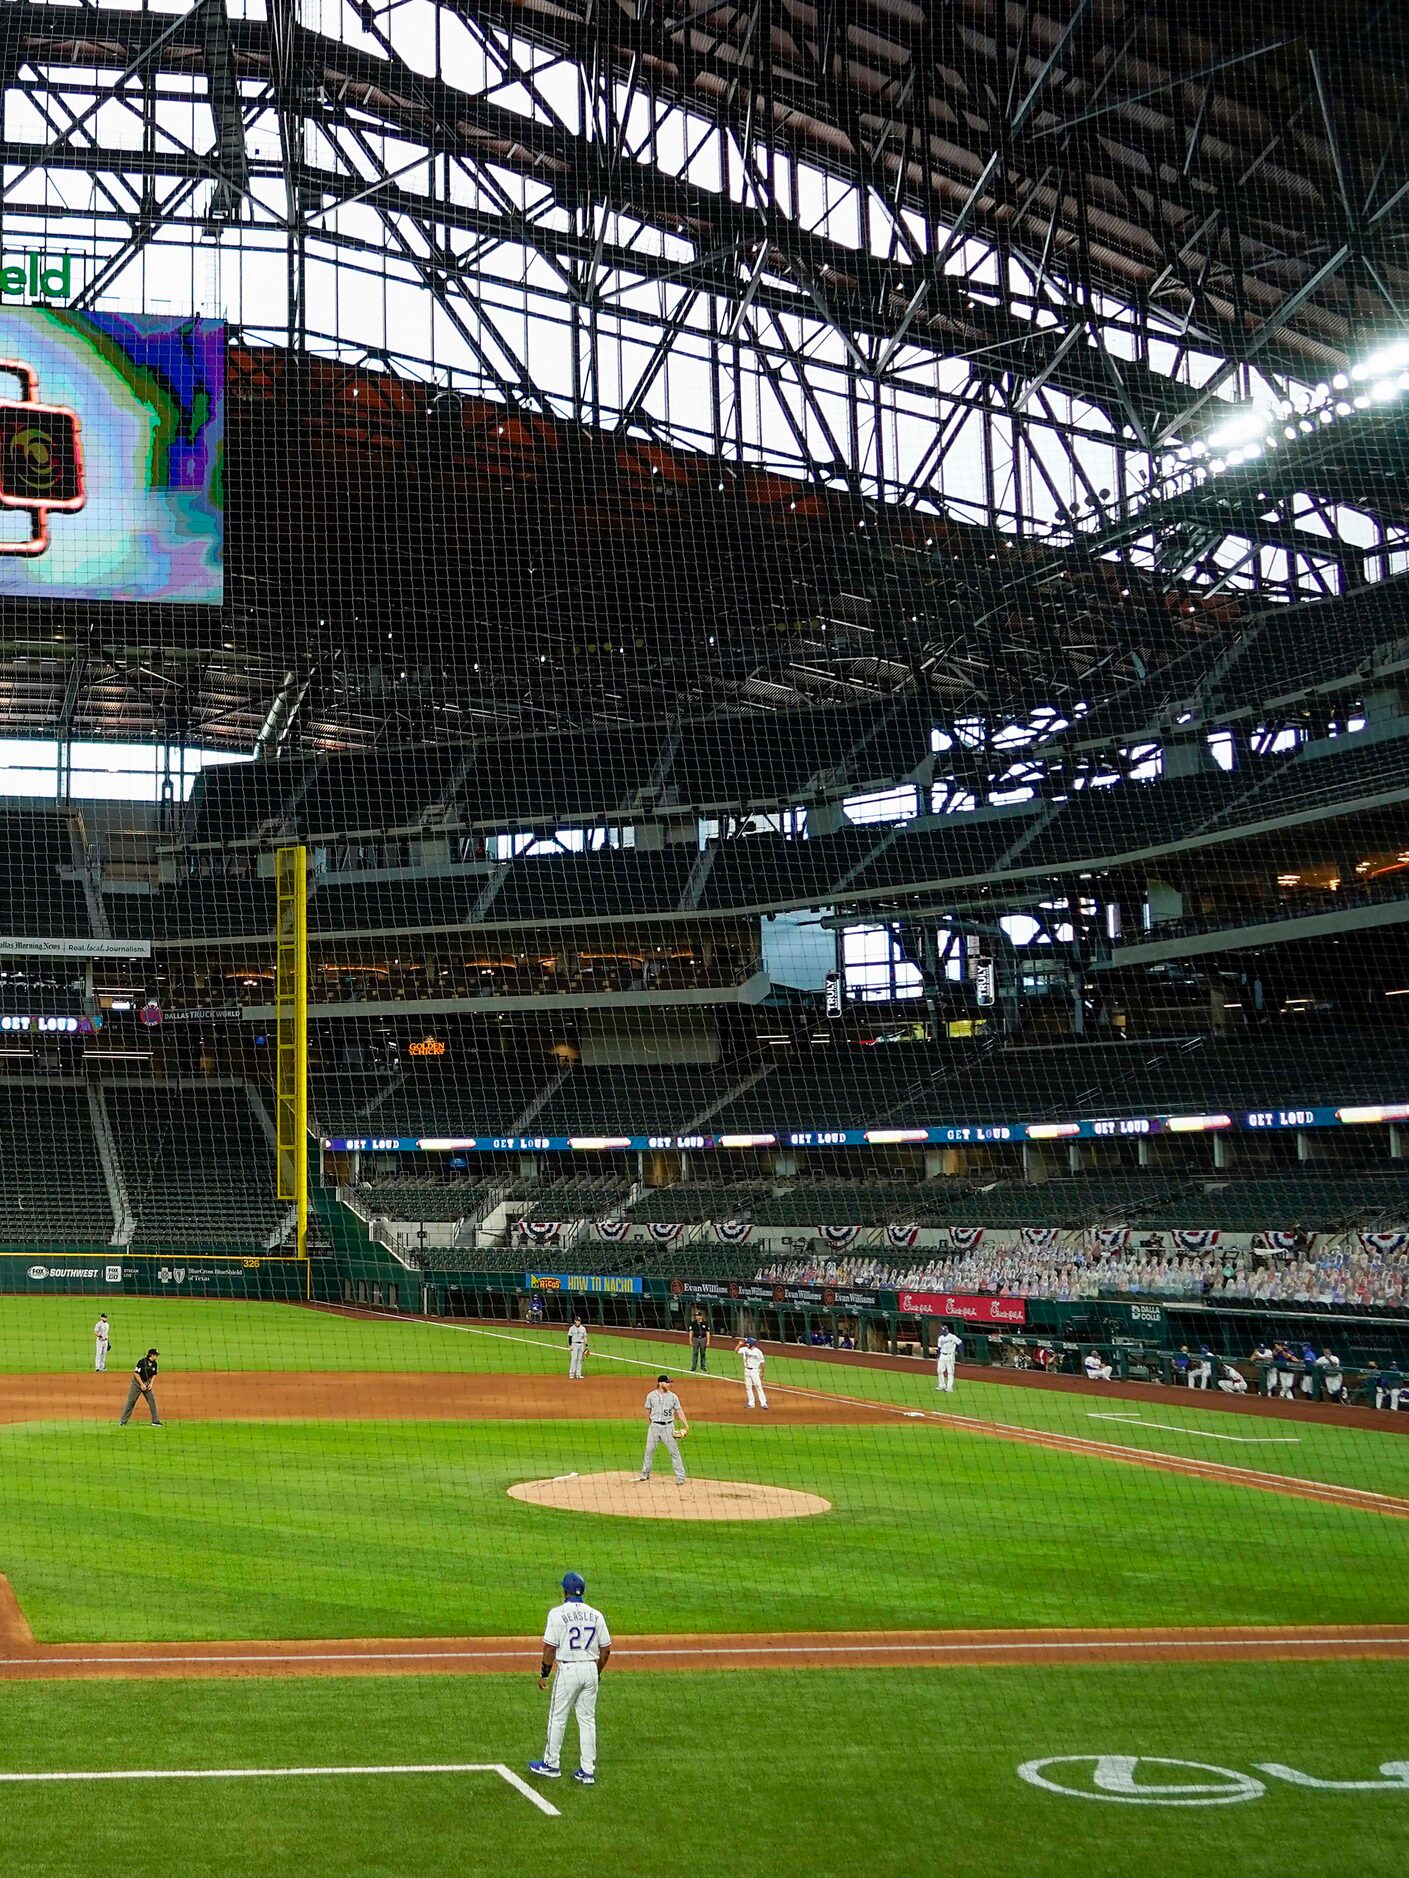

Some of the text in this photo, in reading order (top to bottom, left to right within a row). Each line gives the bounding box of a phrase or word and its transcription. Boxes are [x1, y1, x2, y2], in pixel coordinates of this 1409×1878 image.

[15, 941, 42, 950] Morning
[43, 942, 61, 950] News
[977, 966, 987, 998] TRULY
[826, 979, 835, 1012] TRULY
[164, 1012, 189, 1020] DALLAS
[1, 1016, 78, 1031] GET LOUD
[409, 1042, 445, 1051] GOLDEN
[1248, 1111, 1314, 1127] GET LOUD
[947, 1127, 1011, 1141] GET LOUD
[1094, 1120, 1150, 1135] GET LOUD
[346, 1140, 400, 1150] GET LOUD
[493, 1138, 550, 1149] GET LOUD
[648, 1137, 705, 1148] GET LOUD
[791, 1132, 847, 1145] GET LOUD
[243, 1259, 260, 1268] 326
[49, 1268, 98, 1278] SOUTHWEST
[568, 1276, 634, 1292] HOW TO NACHO
[663, 1408, 673, 1417] 55
[561, 1611, 599, 1624] BEASLEY
[569, 1626, 596, 1650] 27
